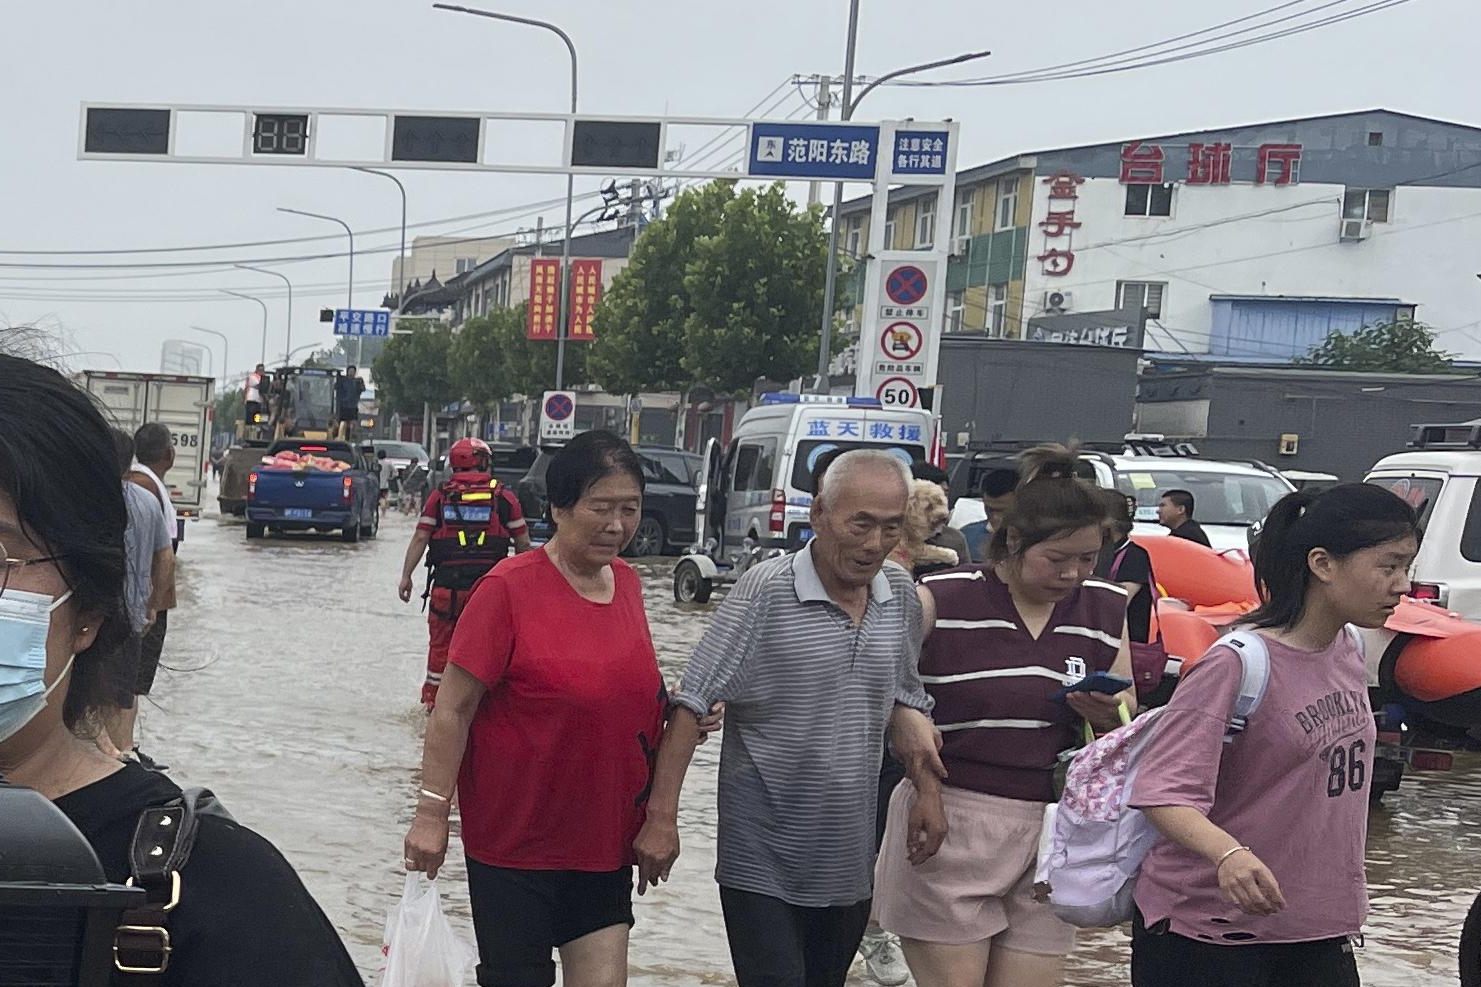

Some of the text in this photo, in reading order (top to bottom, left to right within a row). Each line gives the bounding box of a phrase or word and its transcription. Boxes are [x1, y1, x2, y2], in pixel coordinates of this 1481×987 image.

[787, 138, 870, 165] 范阳东路
[1120, 141, 1304, 186] 台球厅
[884, 388, 910, 404] 50
[807, 420, 920, 441] 蓝天救援
[1327, 739, 1365, 797] 86
